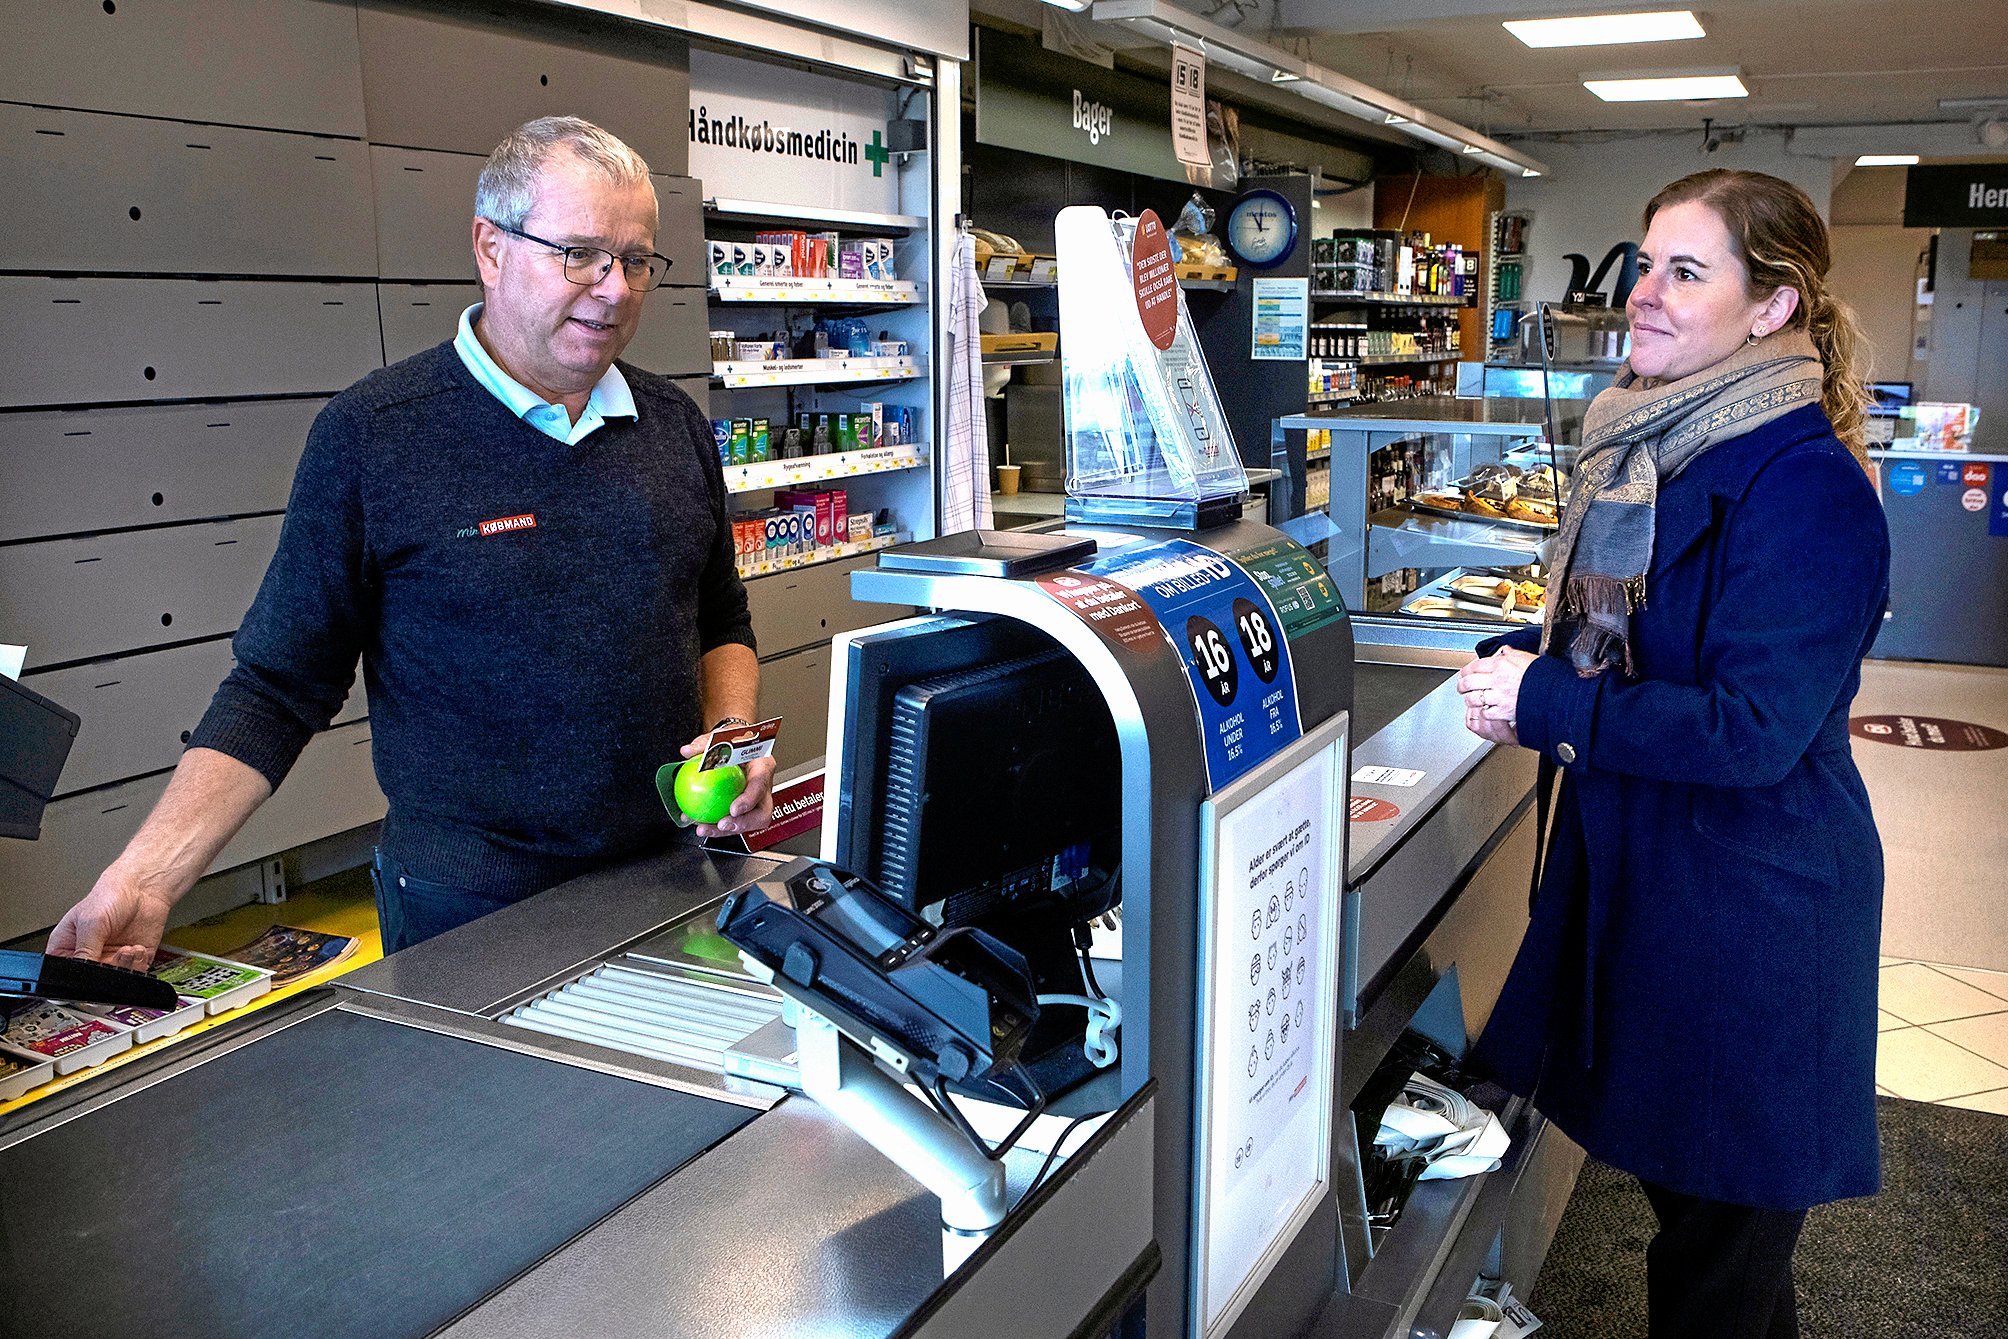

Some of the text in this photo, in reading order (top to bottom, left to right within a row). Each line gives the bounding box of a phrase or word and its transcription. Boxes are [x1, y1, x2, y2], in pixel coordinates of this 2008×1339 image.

[1190, 68, 1199, 89] 18
[1073, 89, 1112, 145] Bager
[1158, 250, 1167, 260] DER
[1140, 271, 1150, 284] BLEV
[1138, 284, 1153, 298] SKULLE
[1152, 277, 1164, 292] OGSÅ
[1144, 300, 1152, 310] UD
[1151, 295, 1158, 306] AT
[482, 517, 534, 535] KØBMAND
[1154, 583, 1180, 599] OM
[1089, 599, 1142, 621] med Dankort
[1240, 612, 1272, 658] 18
[1194, 629, 1230, 679] 16
[1263, 659, 1272, 674] ÅR
[1220, 680, 1231, 695] ÅR
[1262, 689, 1284, 710] ALKOHOL
[1269, 706, 1280, 720] FRA
[1219, 712, 1245, 734] ALKOHOL
[1269, 718, 1284, 735] 16,5%
[1223, 729, 1244, 747] UNDER
[1227, 744, 1243, 761] 16,5%
[783, 803, 796, 815] du
[1249, 854, 1265, 873] Alder
[1266, 848, 1271, 859] er
[1272, 835, 1288, 854] svært
[1288, 830, 1294, 842] at
[1250, 833, 1311, 889] derfor spørger vi om ID
